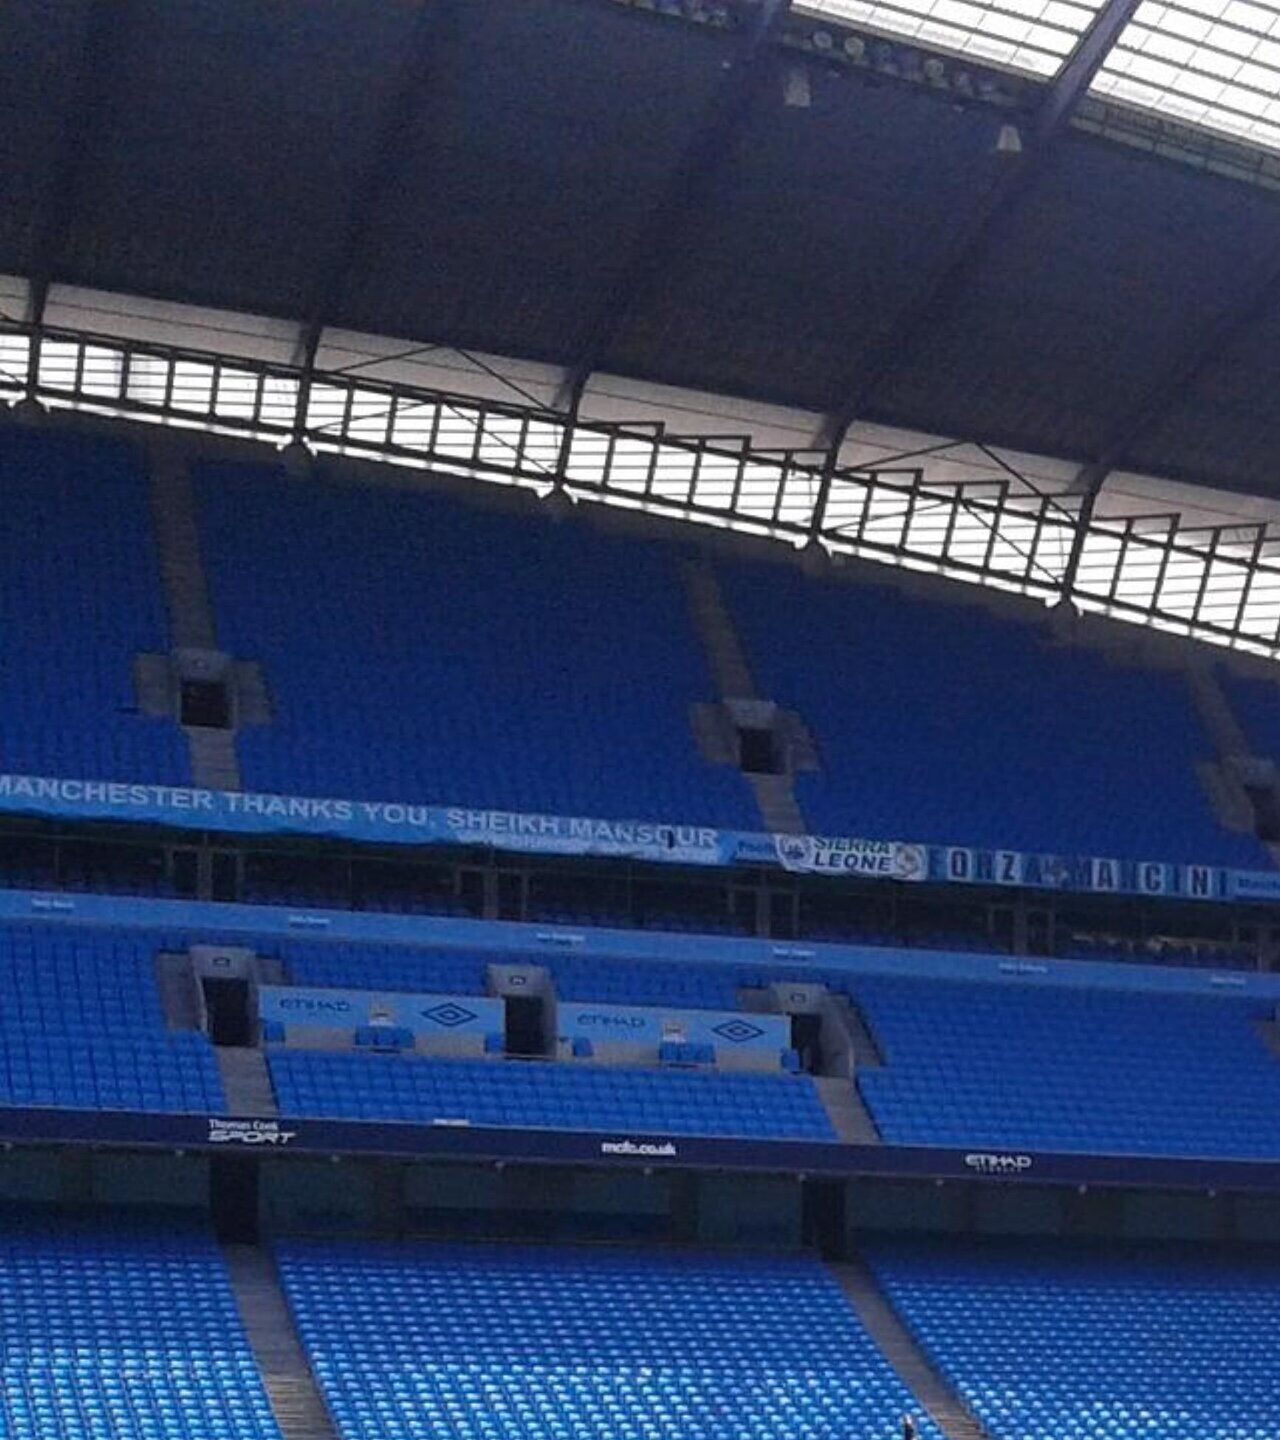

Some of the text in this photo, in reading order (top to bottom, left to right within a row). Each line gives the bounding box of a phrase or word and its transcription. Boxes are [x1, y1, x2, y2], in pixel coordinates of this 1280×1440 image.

[222, 791, 351, 821] THANKS
[447, 808, 559, 836] SHEIKH
[570, 816, 719, 850] MANSOUR
[814, 851, 891, 872] LEONE
